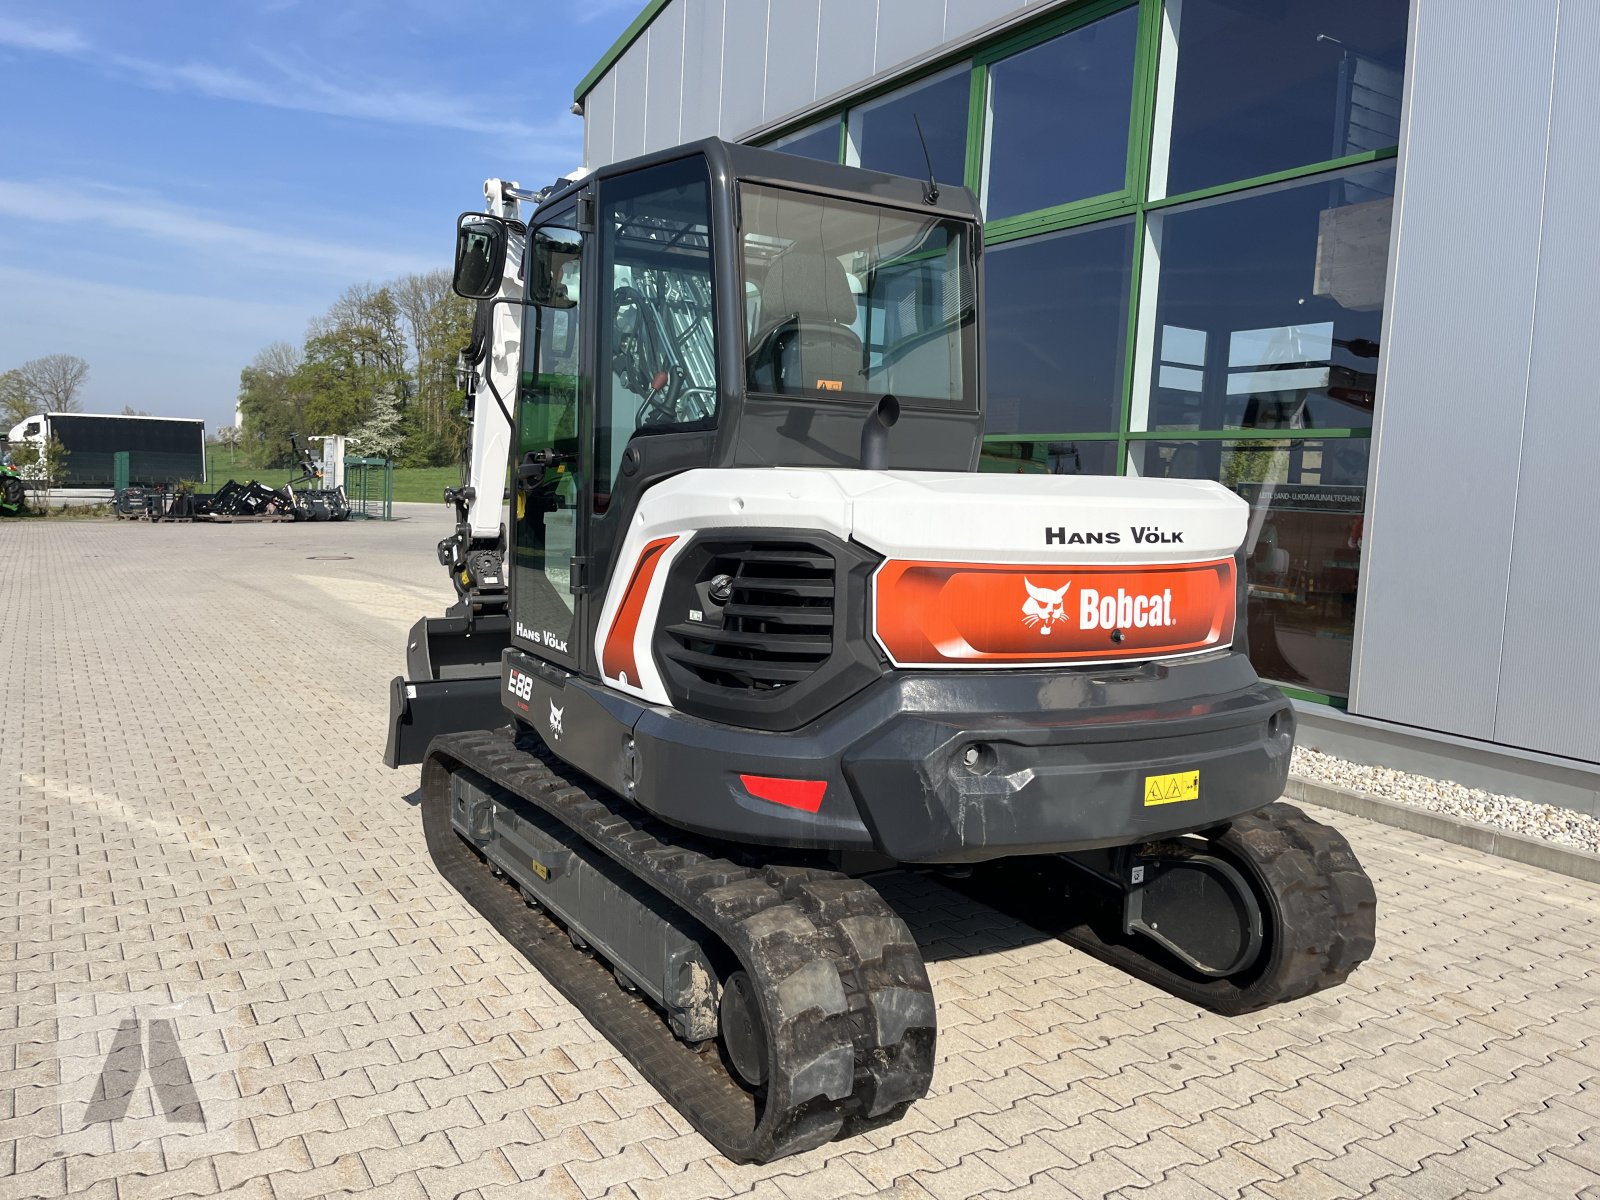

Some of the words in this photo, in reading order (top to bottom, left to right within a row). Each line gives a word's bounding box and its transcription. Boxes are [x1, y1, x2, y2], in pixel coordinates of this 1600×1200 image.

[1045, 527, 1121, 545] HANS
[1130, 526, 1184, 544] VÖLK
[1080, 588, 1173, 630] Bobcat
[516, 621, 541, 643] HANS
[543, 630, 568, 653] VÖLK
[507, 669, 533, 702] E88
